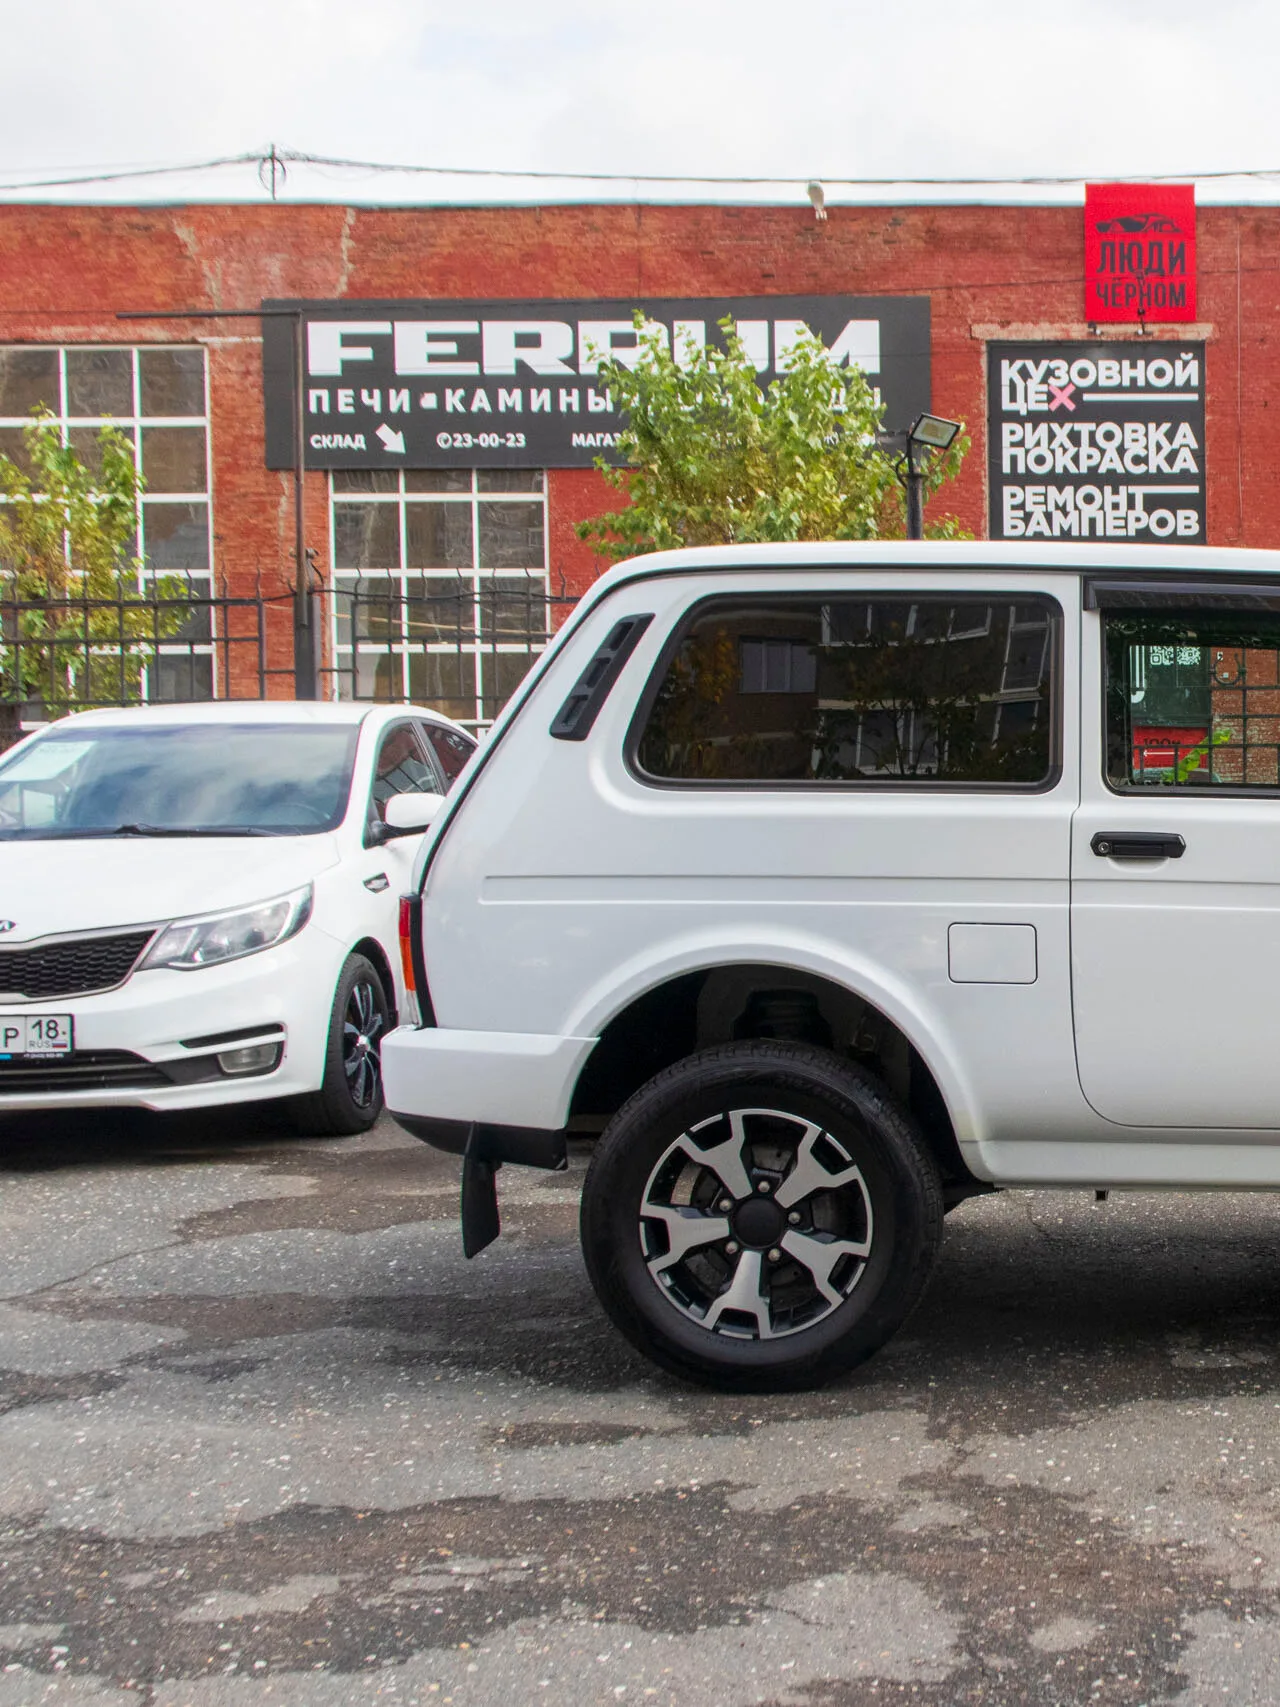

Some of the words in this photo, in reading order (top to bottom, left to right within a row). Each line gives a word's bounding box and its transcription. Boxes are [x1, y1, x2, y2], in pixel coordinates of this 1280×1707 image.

[1096, 241, 1186, 276] ЛЮДИ
[307, 320, 881, 376] FERRUM
[1001, 352, 1199, 387] КУЗОВНОЙ
[308, 388, 411, 414] ПЕЧИ
[444, 387, 615, 414] КАМИНЫ
[1001, 383, 1076, 416] ЦЕХ
[309, 434, 367, 451] СКЛАД
[1002, 422, 1198, 450] РИХТОВКА
[1002, 446, 1199, 475] ПОКРАСКА
[1002, 485, 1144, 512] РЕМОНТ
[1002, 509, 1200, 537] БАМПЕРОВ
[31, 1019, 59, 1040] 18
[29, 1040, 50, 1048] RUS
